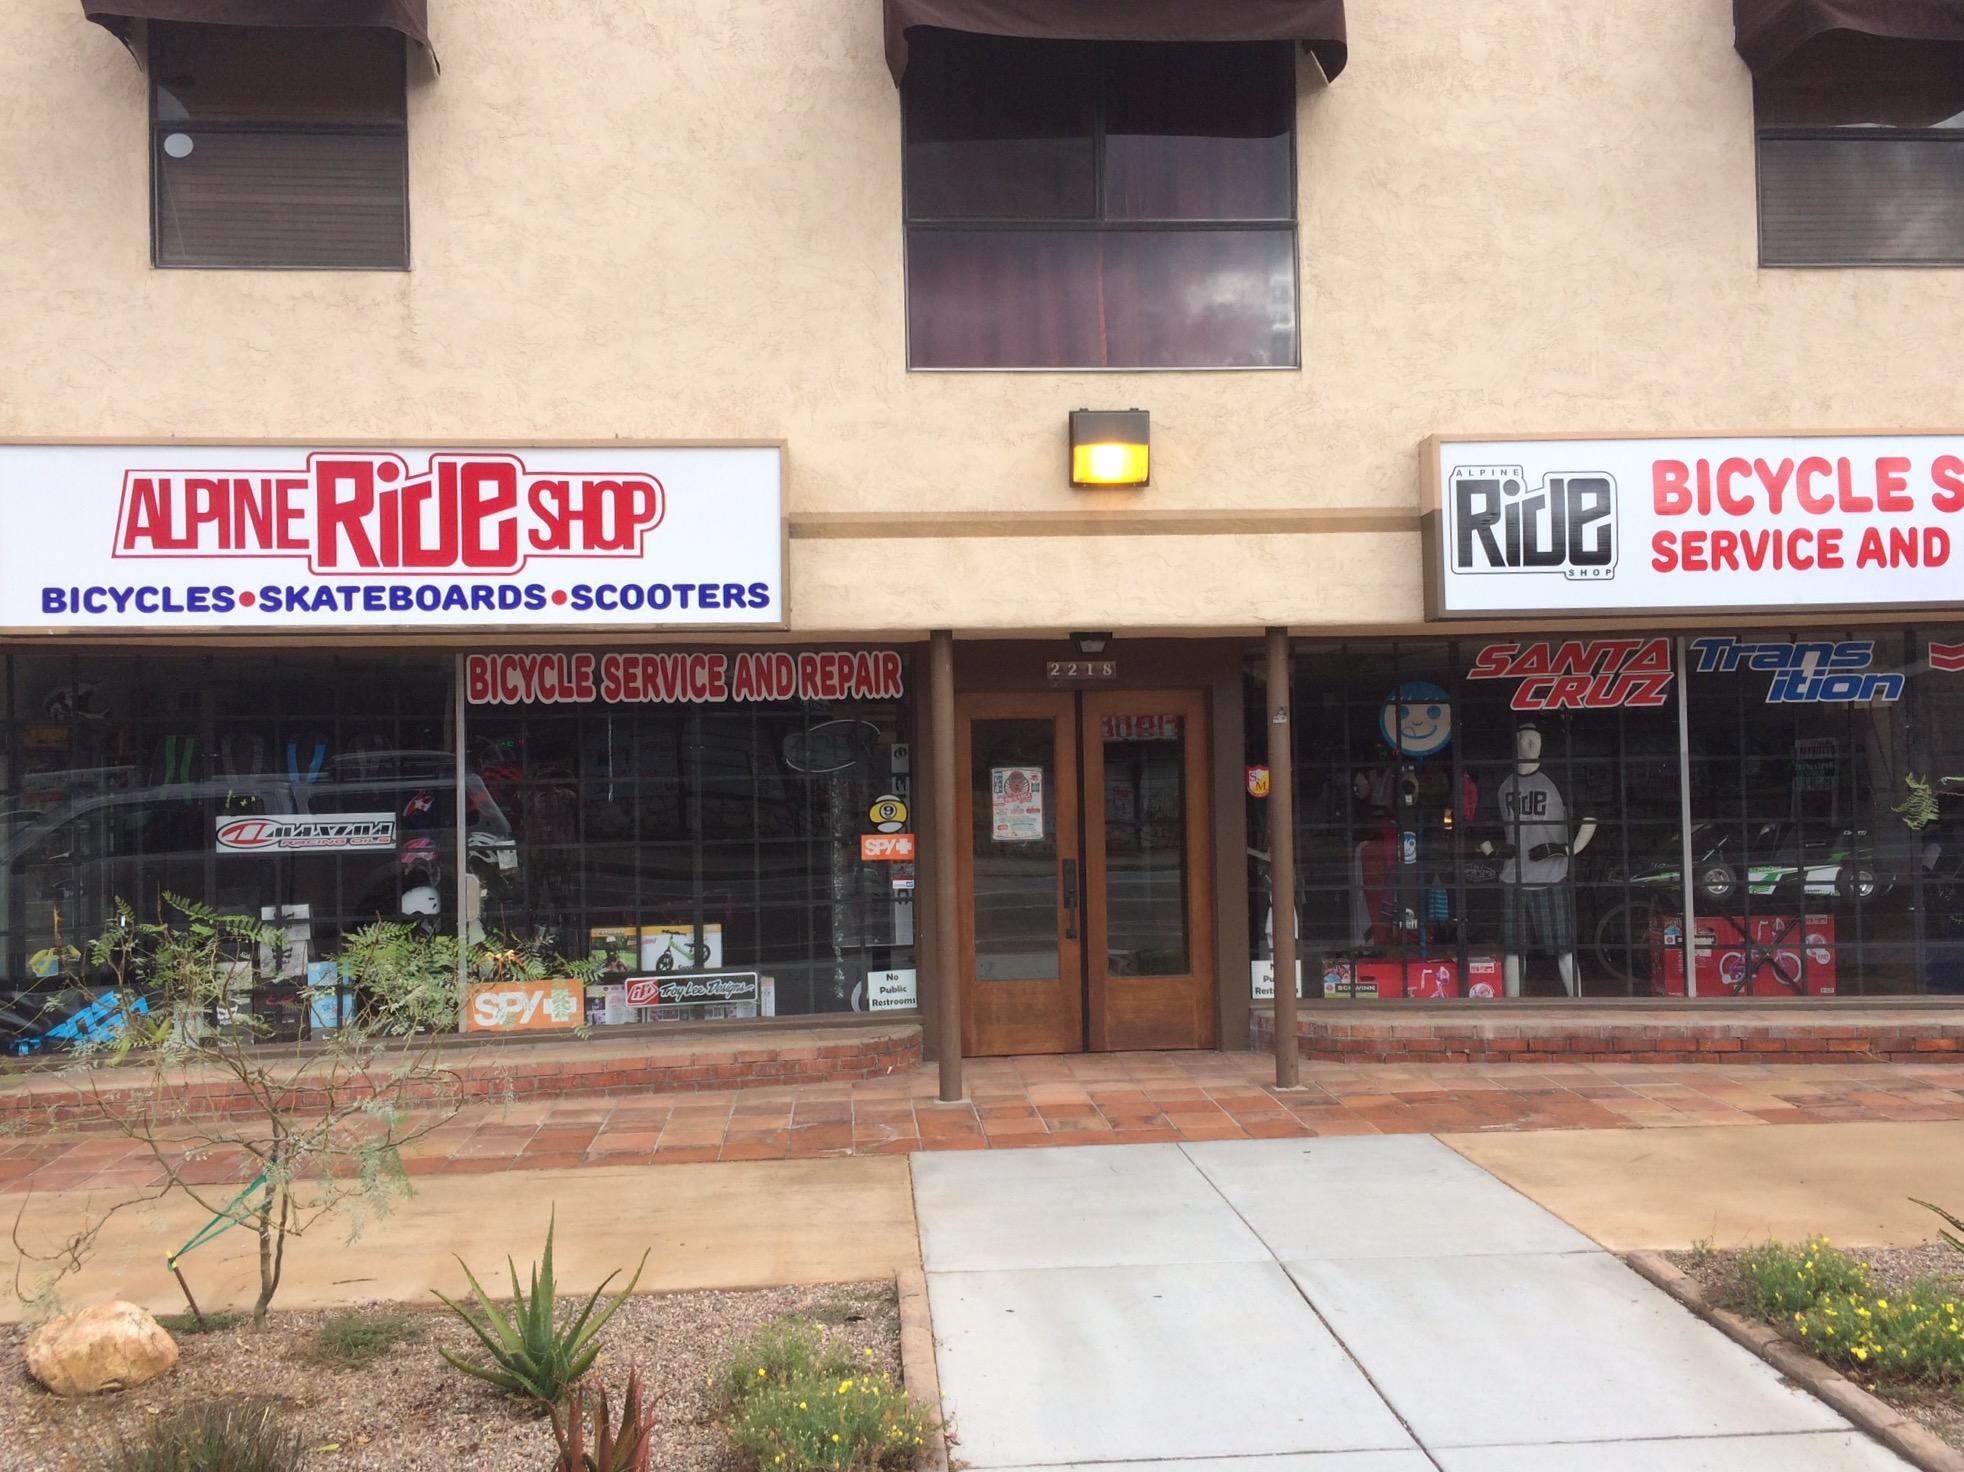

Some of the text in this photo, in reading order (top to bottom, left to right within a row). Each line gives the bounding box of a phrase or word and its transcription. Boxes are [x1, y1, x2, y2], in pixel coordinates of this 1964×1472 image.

[1456, 468, 1520, 477] ALPINE
[1652, 456, 1914, 516] BICYCLE
[123, 478, 309, 549] ALPINE
[528, 479, 657, 550] SHOP
[1651, 526, 1950, 573] SERVICE AND
[1568, 568, 1612, 577] SHOP
[41, 581, 770, 613] BICYCLES SKATEBOARDS SCOOTERS
[1050, 662, 1112, 676] 2218
[1467, 637, 1670, 679] SANTA
[1690, 637, 1876, 672] Trans
[467, 652, 904, 703] BICYCLE SERVICE AND REPAIR
[1511, 672, 1674, 710] CRUZ
[1766, 668, 1905, 704] ition
[883, 805, 894, 816] 9
[1505, 790, 1547, 816] Rde
[865, 838, 897, 856] SPY
[660, 979, 755, 1002] Troy Lee Designs
[880, 985, 907, 994] Public
[886, 973, 899, 981] No
[473, 990, 544, 1027] SPY
[872, 998, 916, 1007] Restrooms
